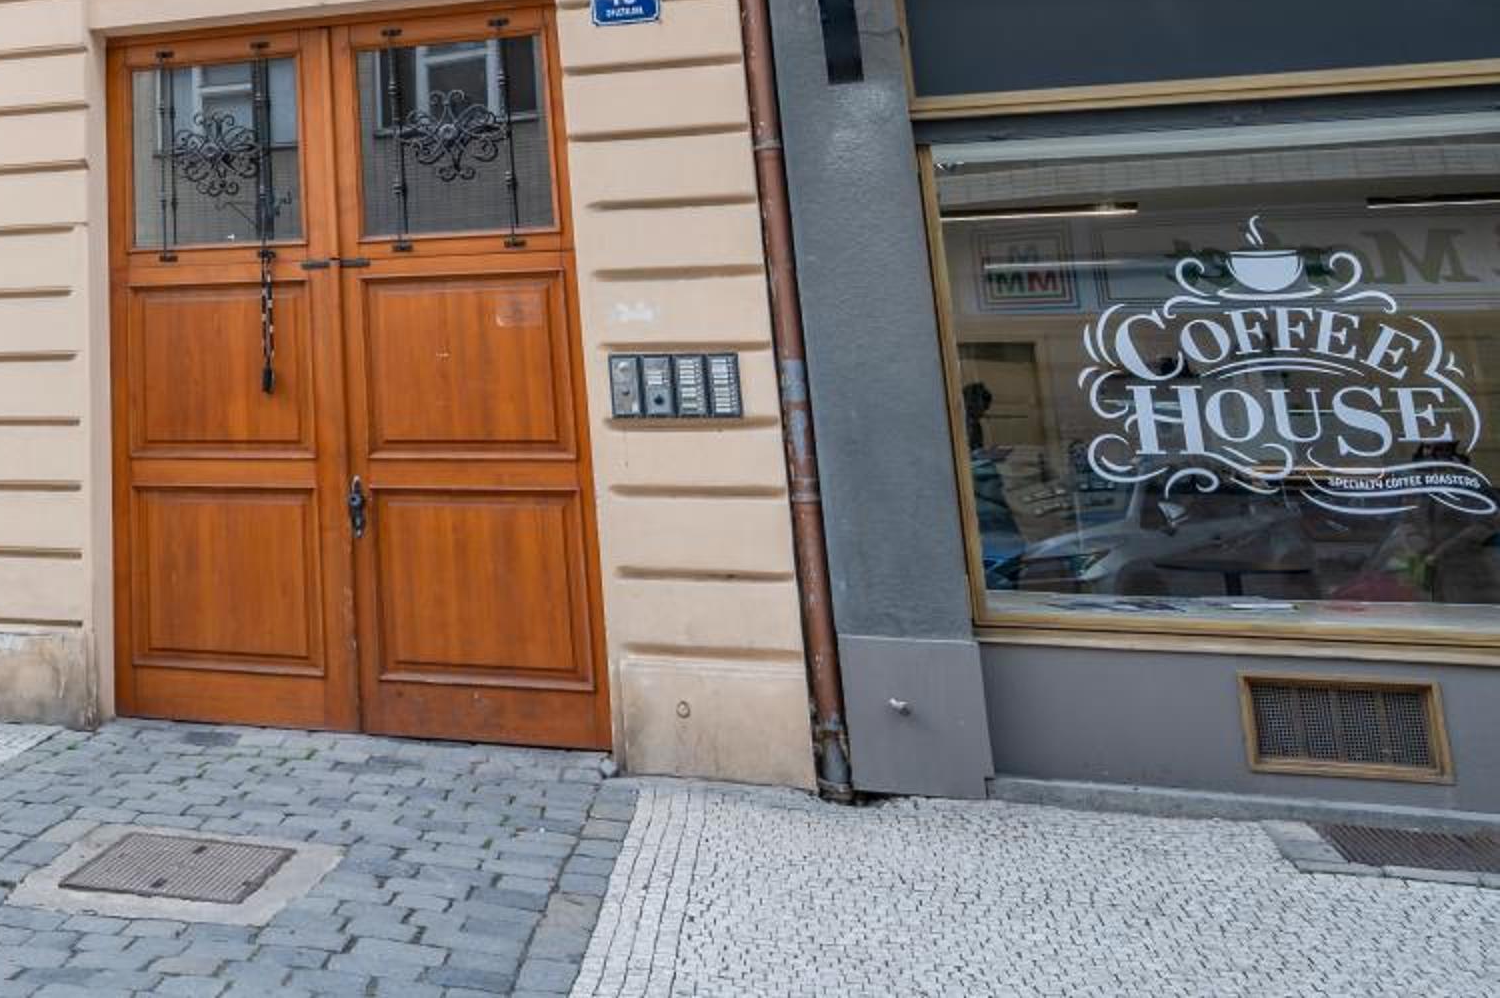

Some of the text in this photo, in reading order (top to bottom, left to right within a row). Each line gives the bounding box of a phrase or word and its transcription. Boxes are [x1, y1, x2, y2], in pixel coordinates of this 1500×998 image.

[1115, 307, 1421, 381] COFFEE
[1125, 385, 1453, 457] HOUSE
[1385, 474, 1423, 489] COFFEE
[1425, 473, 1481, 489] ROASTERS
